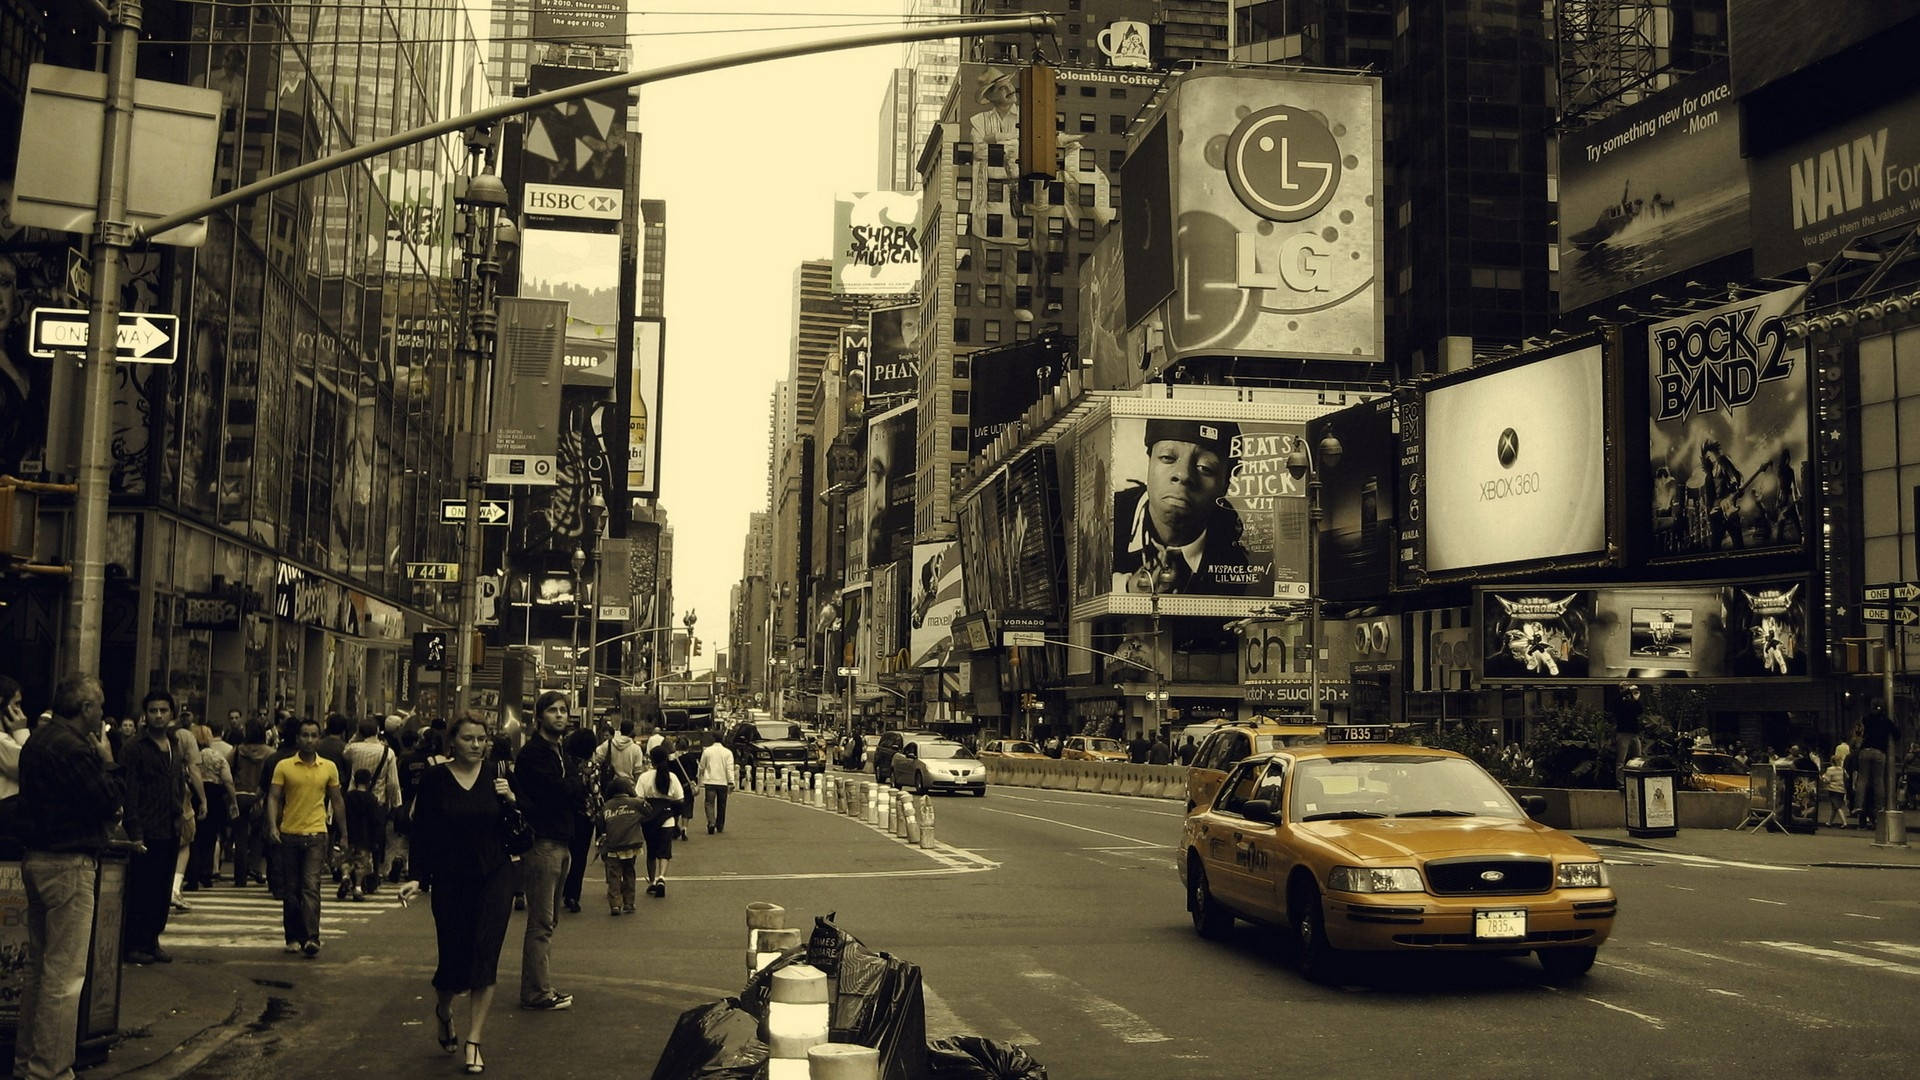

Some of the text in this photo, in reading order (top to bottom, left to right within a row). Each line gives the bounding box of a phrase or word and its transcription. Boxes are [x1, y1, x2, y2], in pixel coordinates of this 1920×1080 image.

[591, 21, 608, 29] 100.
[1120, 74, 1161, 86] Coffee
[1586, 84, 1732, 163] Try something new for once.
[1790, 128, 1888, 230] NAVY
[530, 191, 586, 211] HSBC
[850, 225, 919, 251] SHREK
[1802, 234, 1818, 247] You
[1819, 228, 1838, 243] gave
[1839, 220, 1860, 236] them
[1861, 212, 1876, 227] the
[854, 247, 919, 267] MUSICAL
[1236, 231, 1333, 293] LG
[1655, 304, 1794, 385] ROCK 2
[1655, 357, 1760, 423] BAND
[1229, 435, 1291, 458] BEATS
[1238, 459, 1281, 475] THAT
[1228, 472, 1297, 498] STICK
[1479, 471, 1540, 503] XBOX 360
[407, 565, 447, 579] W 44 ST
[1870, 587, 1917, 599] ONE WAY
[1003, 618, 1046, 626] VORNADO
[1868, 609, 1912, 620] ONE WAY
[1344, 727, 1371, 741] 7B35
